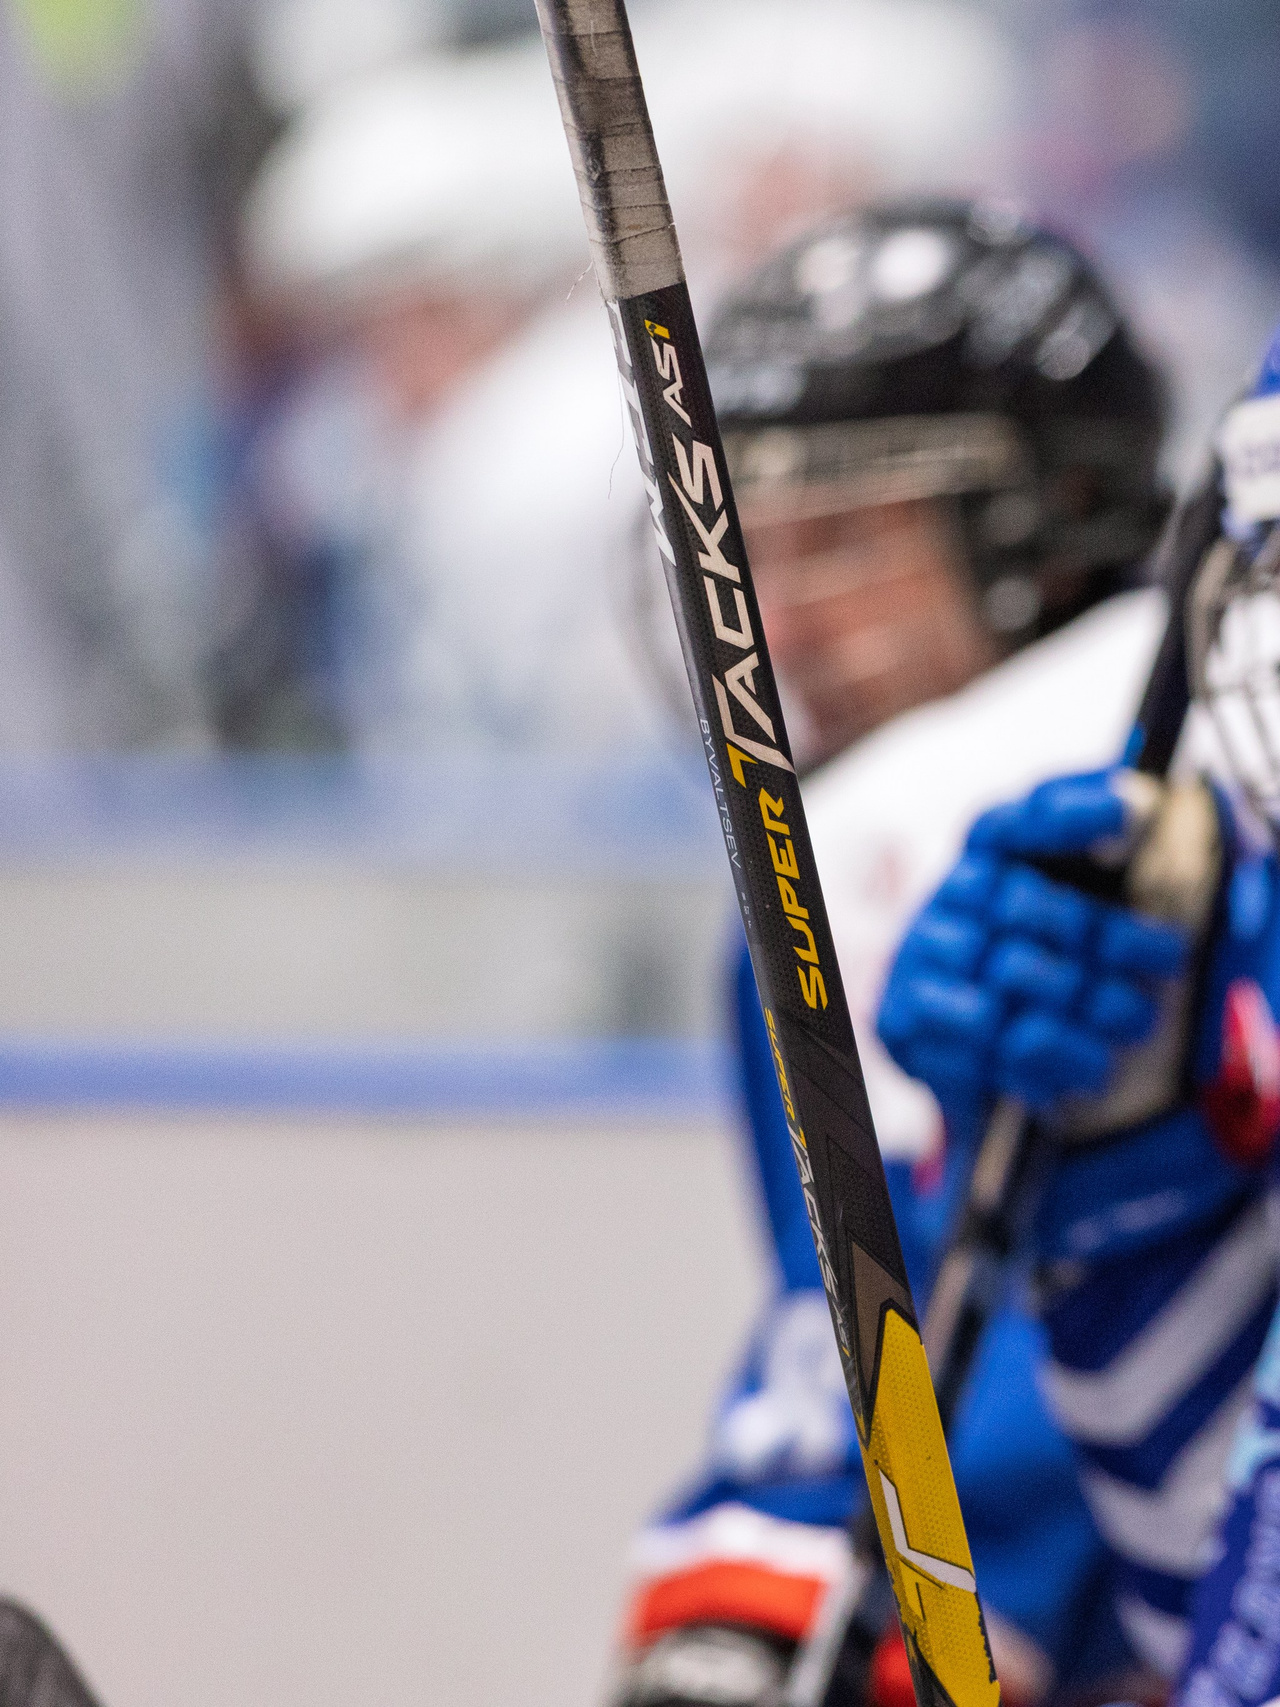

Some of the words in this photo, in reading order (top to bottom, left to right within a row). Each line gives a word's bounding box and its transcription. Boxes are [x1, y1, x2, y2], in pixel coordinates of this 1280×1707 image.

[667, 432, 796, 787] TACKS
[700, 718, 742, 869] BYVALTSEV
[758, 787, 828, 1010] SUPER
[764, 1006, 796, 1121] SUPER
[787, 1123, 838, 1301] TACKS
